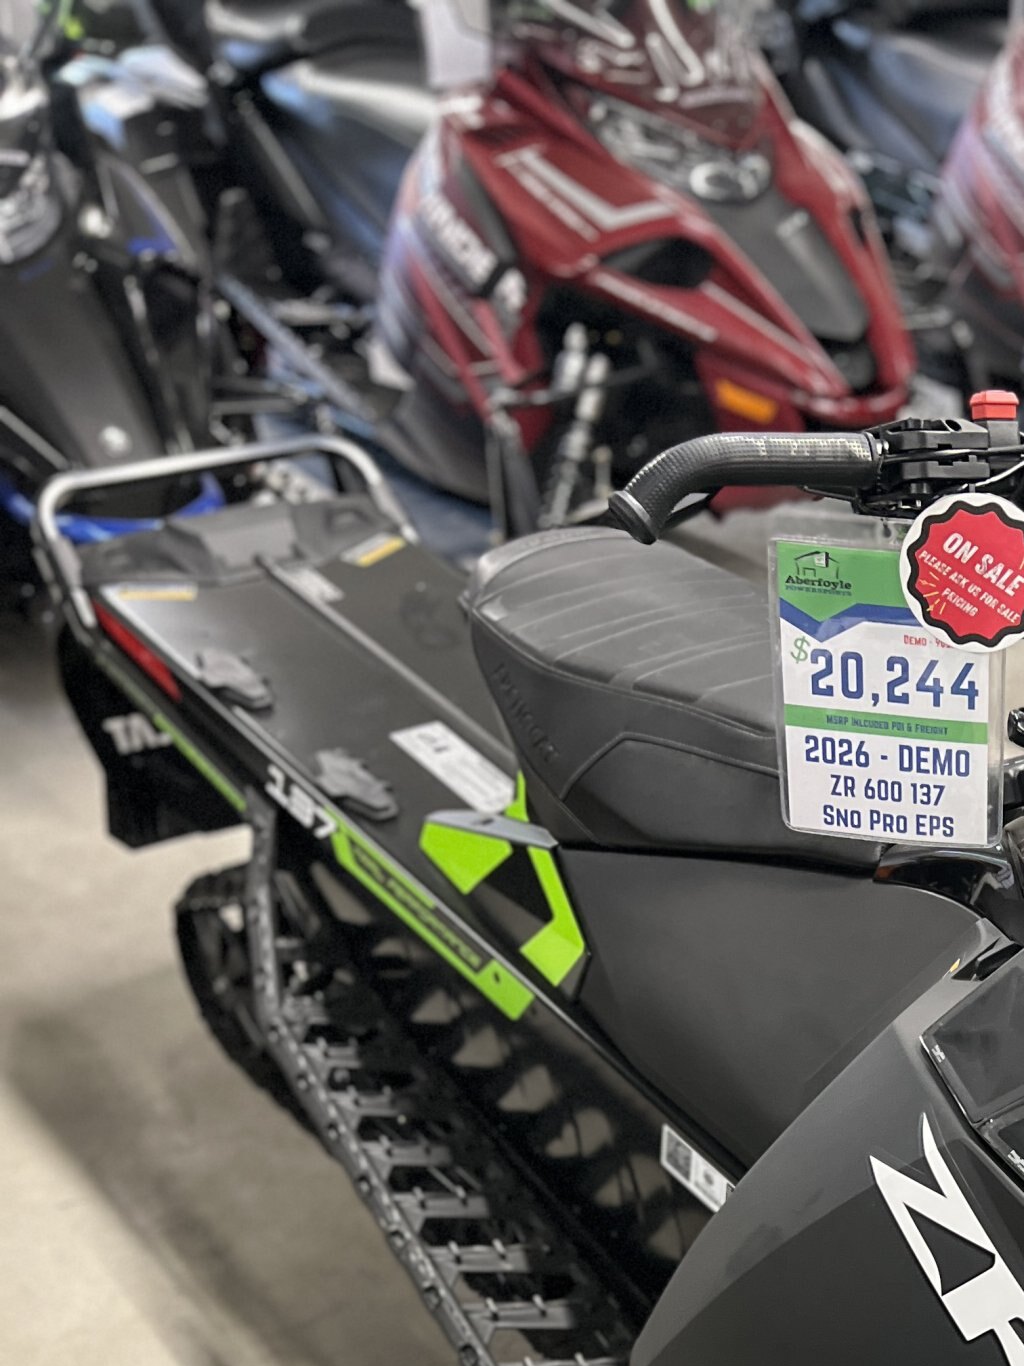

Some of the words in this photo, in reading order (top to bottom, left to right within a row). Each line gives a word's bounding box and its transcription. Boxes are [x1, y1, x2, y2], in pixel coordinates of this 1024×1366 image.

[943, 532, 978, 564] ON
[785, 576, 852, 590] Aberfoyle
[918, 550, 952, 576] PLEASE
[948, 570, 970, 589] ASK
[968, 583, 979, 598] US
[980, 592, 998, 610] FOR
[996, 604, 1020, 624] SALE
[941, 588, 978, 617] PRICING
[904, 634, 927, 646] DEMO
[826, 714, 849, 726] MSRP
[804, 734, 870, 768] 2026
[899, 744, 970, 777] DEMO
[830, 774, 856, 798] ZR
[864, 778, 902, 802] 600
[910, 782, 946, 806] 137
[916, 814, 954, 838] EPS
